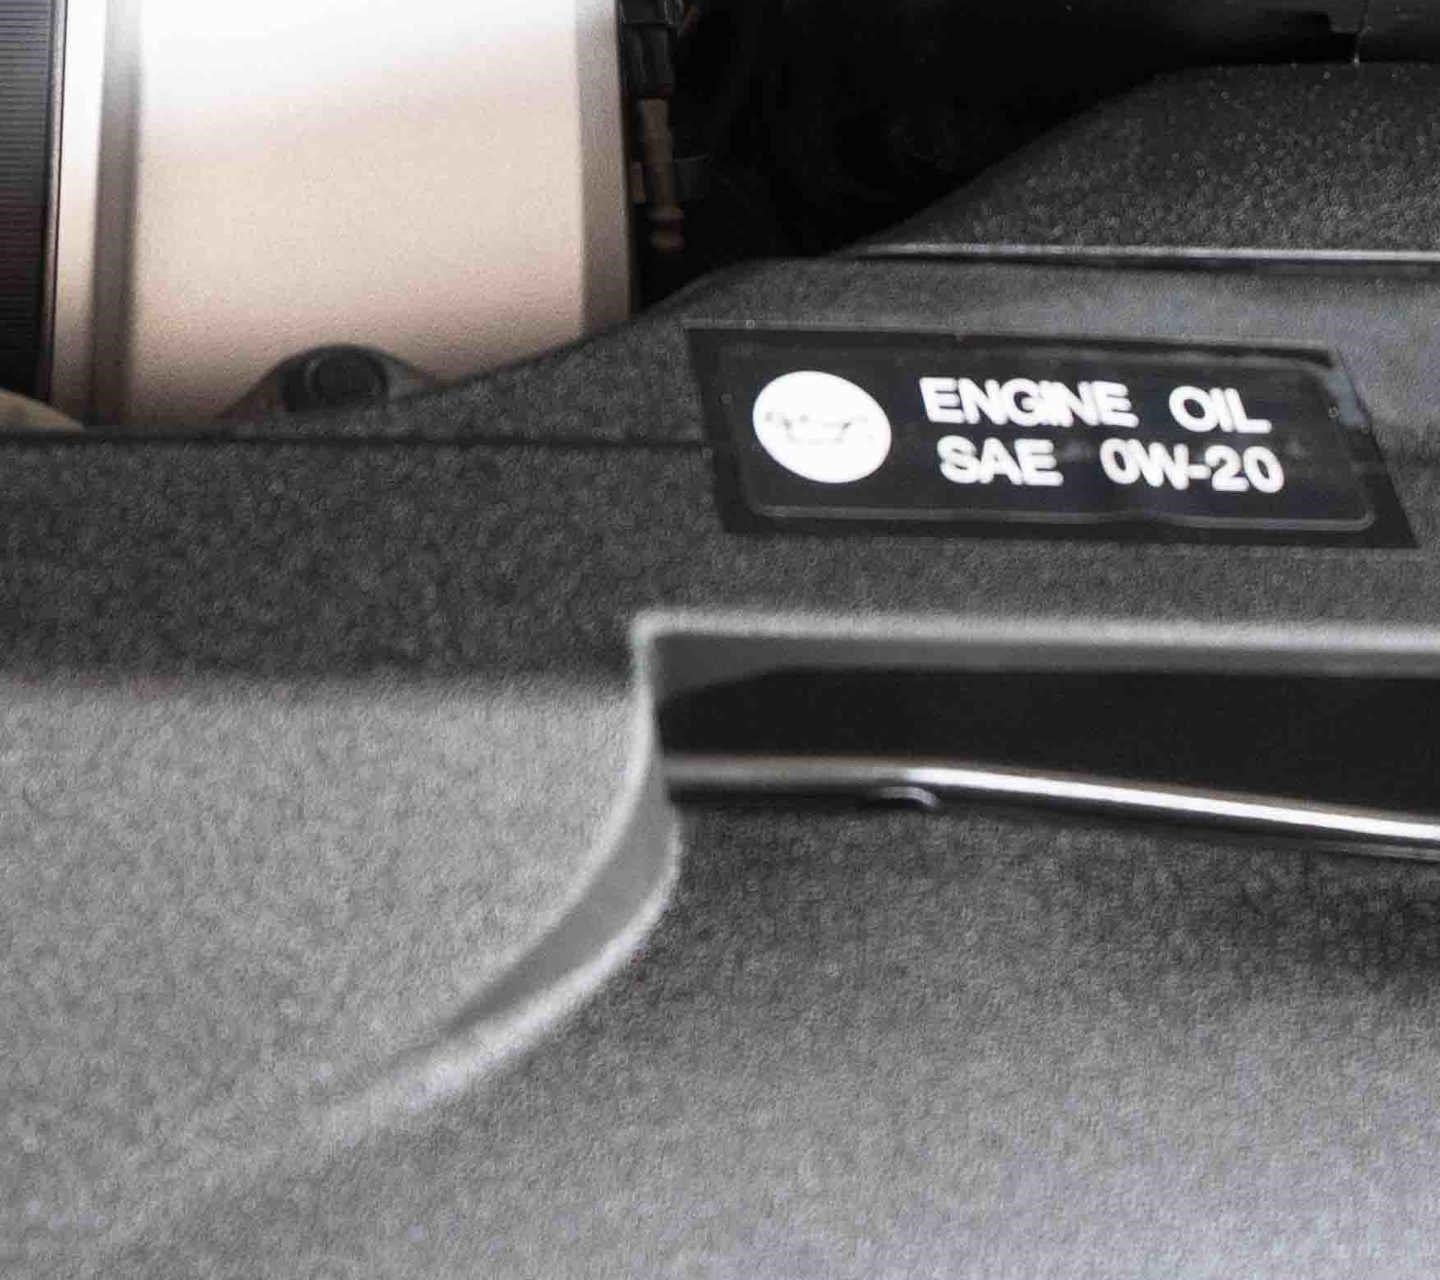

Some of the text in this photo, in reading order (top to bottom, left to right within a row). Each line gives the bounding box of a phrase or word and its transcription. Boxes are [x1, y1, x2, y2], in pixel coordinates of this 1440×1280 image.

[919, 376, 1271, 434] ENGINE OIL
[938, 437, 1284, 494] SAE 0W-20
